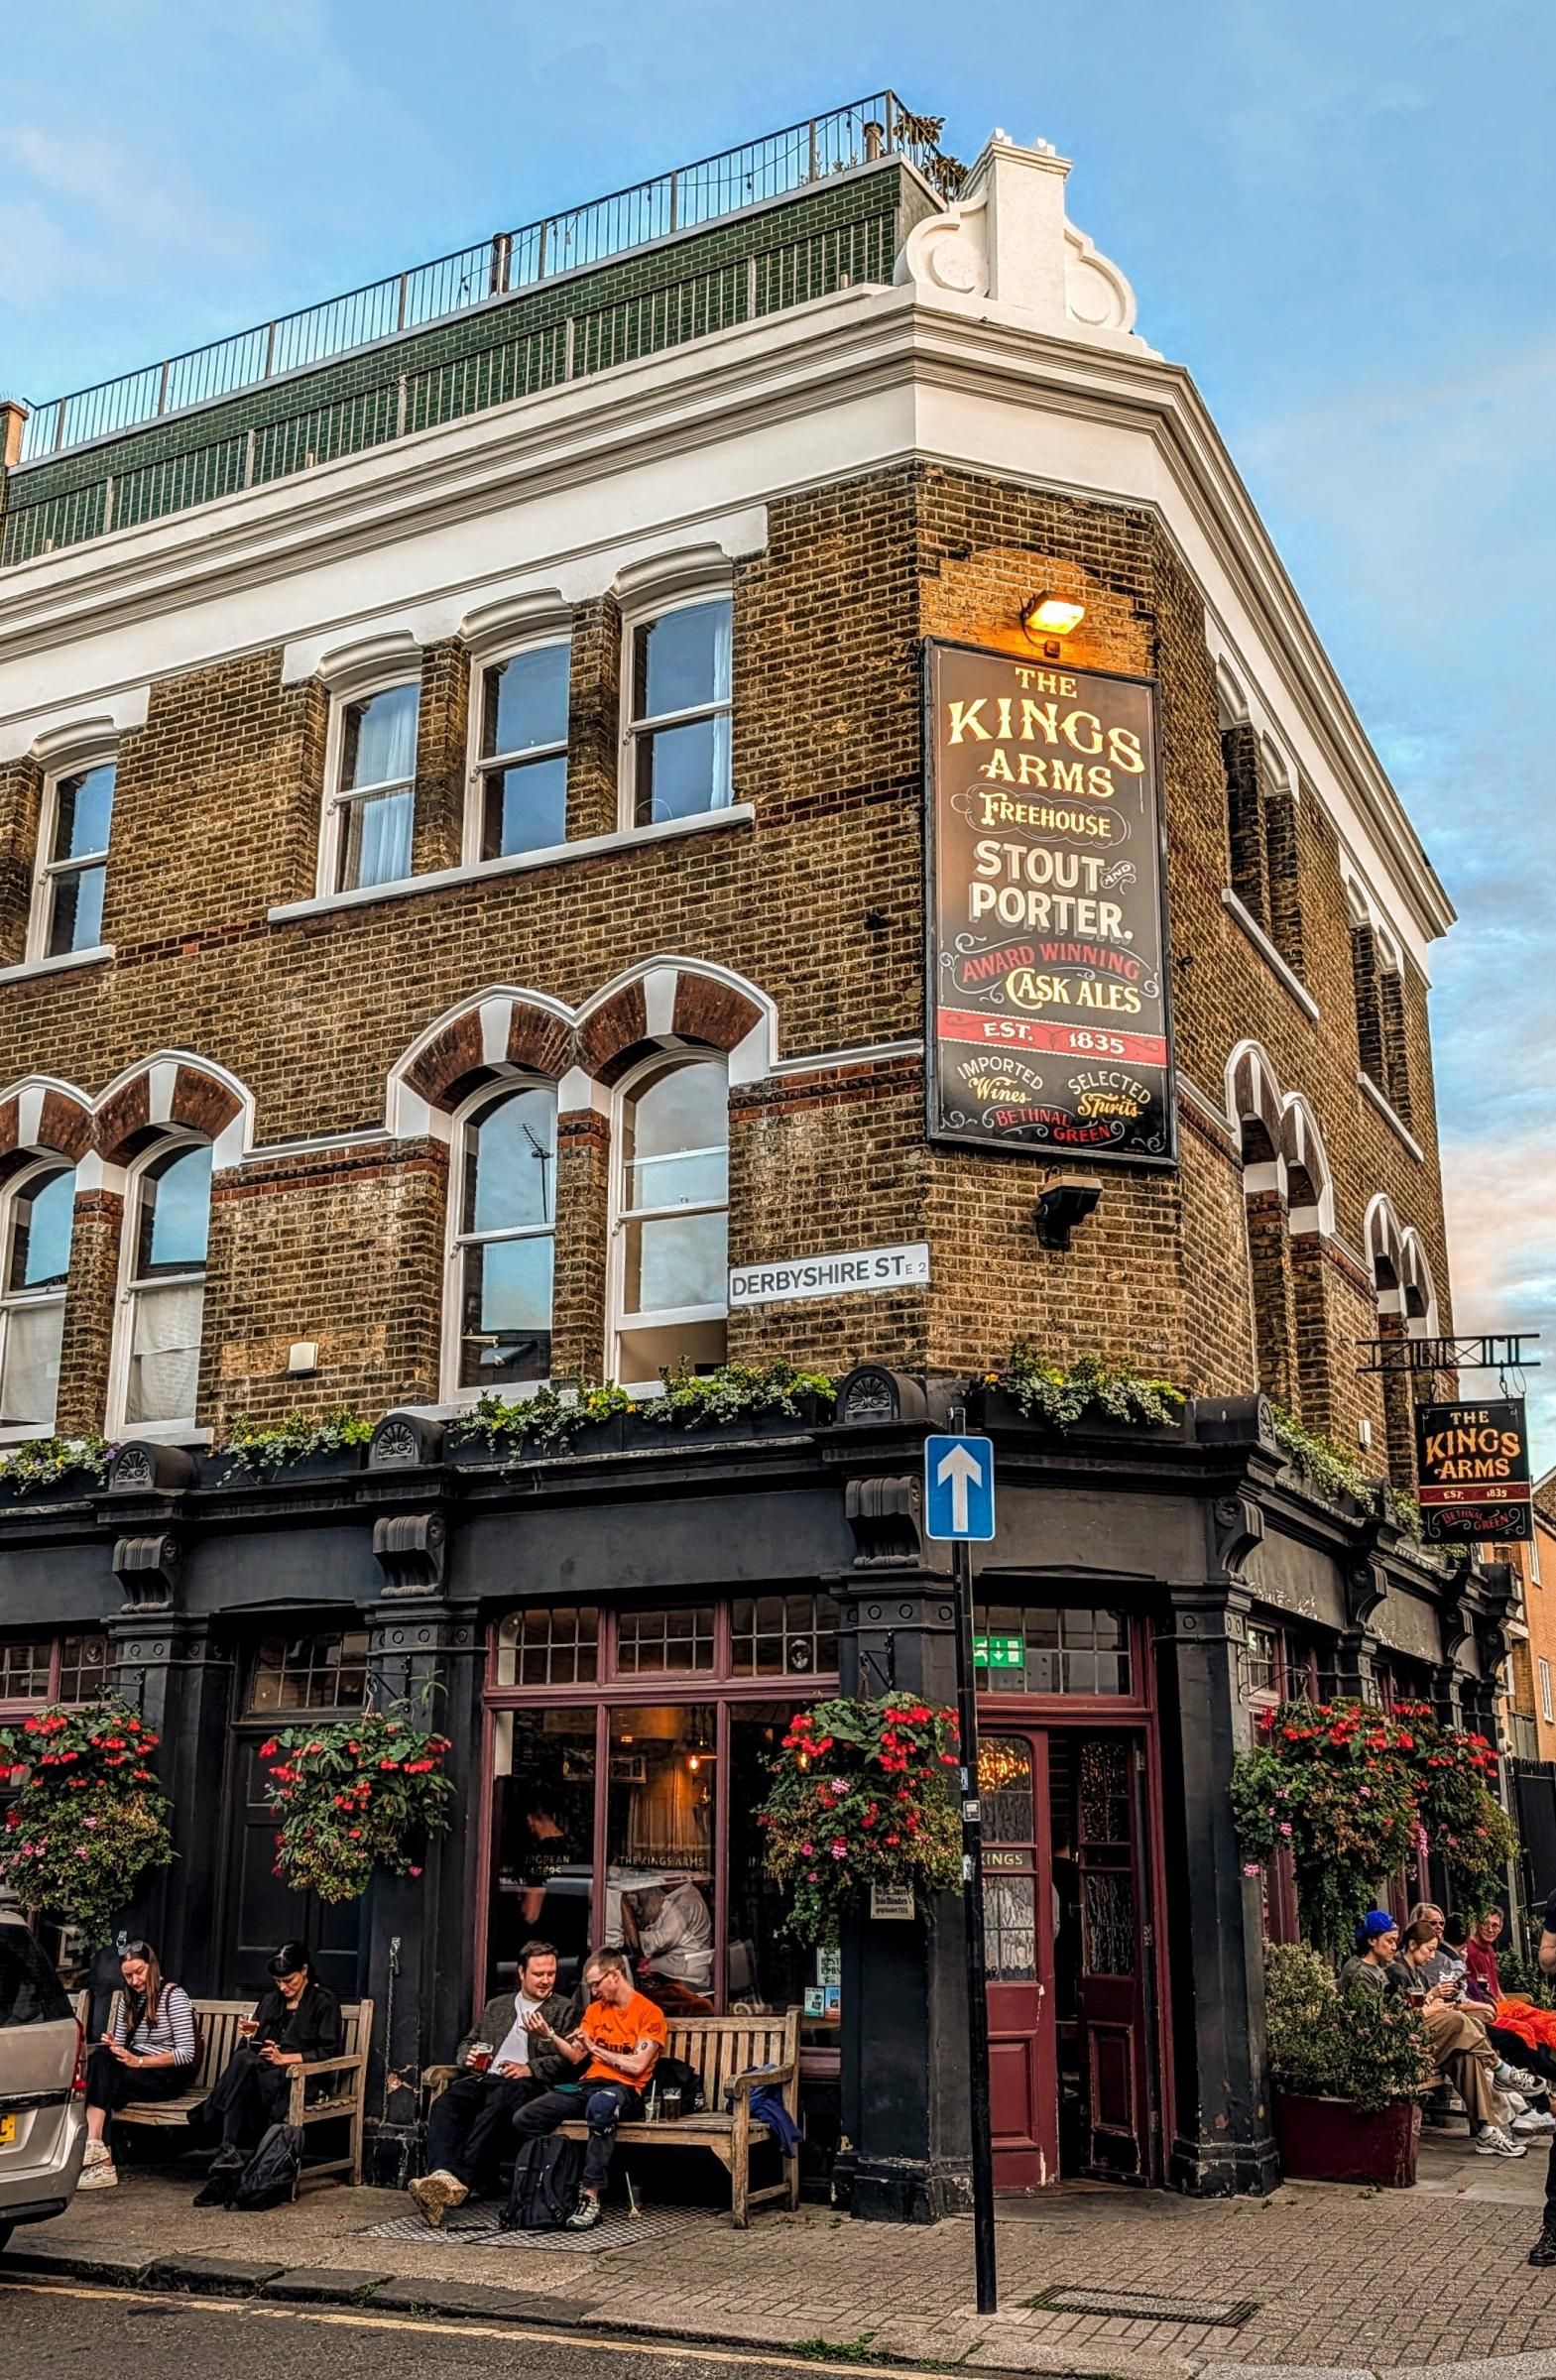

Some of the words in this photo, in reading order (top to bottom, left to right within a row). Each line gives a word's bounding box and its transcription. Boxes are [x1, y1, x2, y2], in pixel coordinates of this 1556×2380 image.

[1015, 666, 1078, 699] THE
[947, 697, 1146, 775] KINGS
[977, 748, 1116, 798] ARMS
[973, 839, 1106, 895] STOUT
[1104, 862, 1133, 885] AND
[968, 882, 1136, 946] PORTER.
[962, 945, 1036, 984] AWARD
[1038, 942, 1141, 981] WINNING
[1075, 980, 1142, 1014] ALES
[983, 1020, 1034, 1042] EST.
[1068, 1031, 1126, 1055] 1835
[956, 1055, 1045, 1092] IMPORTED
[968, 1076, 1032, 1105] Wines
[1067, 1070, 1152, 1106] SELECTED
[995, 1108, 1071, 1129] BETHNAL
[1076, 1091, 1143, 1120] Spirits
[1052, 1124, 1112, 1143] GREEN
[732, 1259, 870, 1297] DERBYSHIRE
[874, 1254, 905, 1279] ST
[1450, 1410, 1490, 1426] THE
[1425, 1427, 1521, 1468] KINGS
[1434, 1458, 1511, 1481] ARMS
[1443, 1489, 1465, 1500] EST.
[1487, 1487, 1507, 1498] 1835
[1441, 1510, 1483, 1524] BETHNAL
[1473, 1512, 1509, 1531] GREEN
